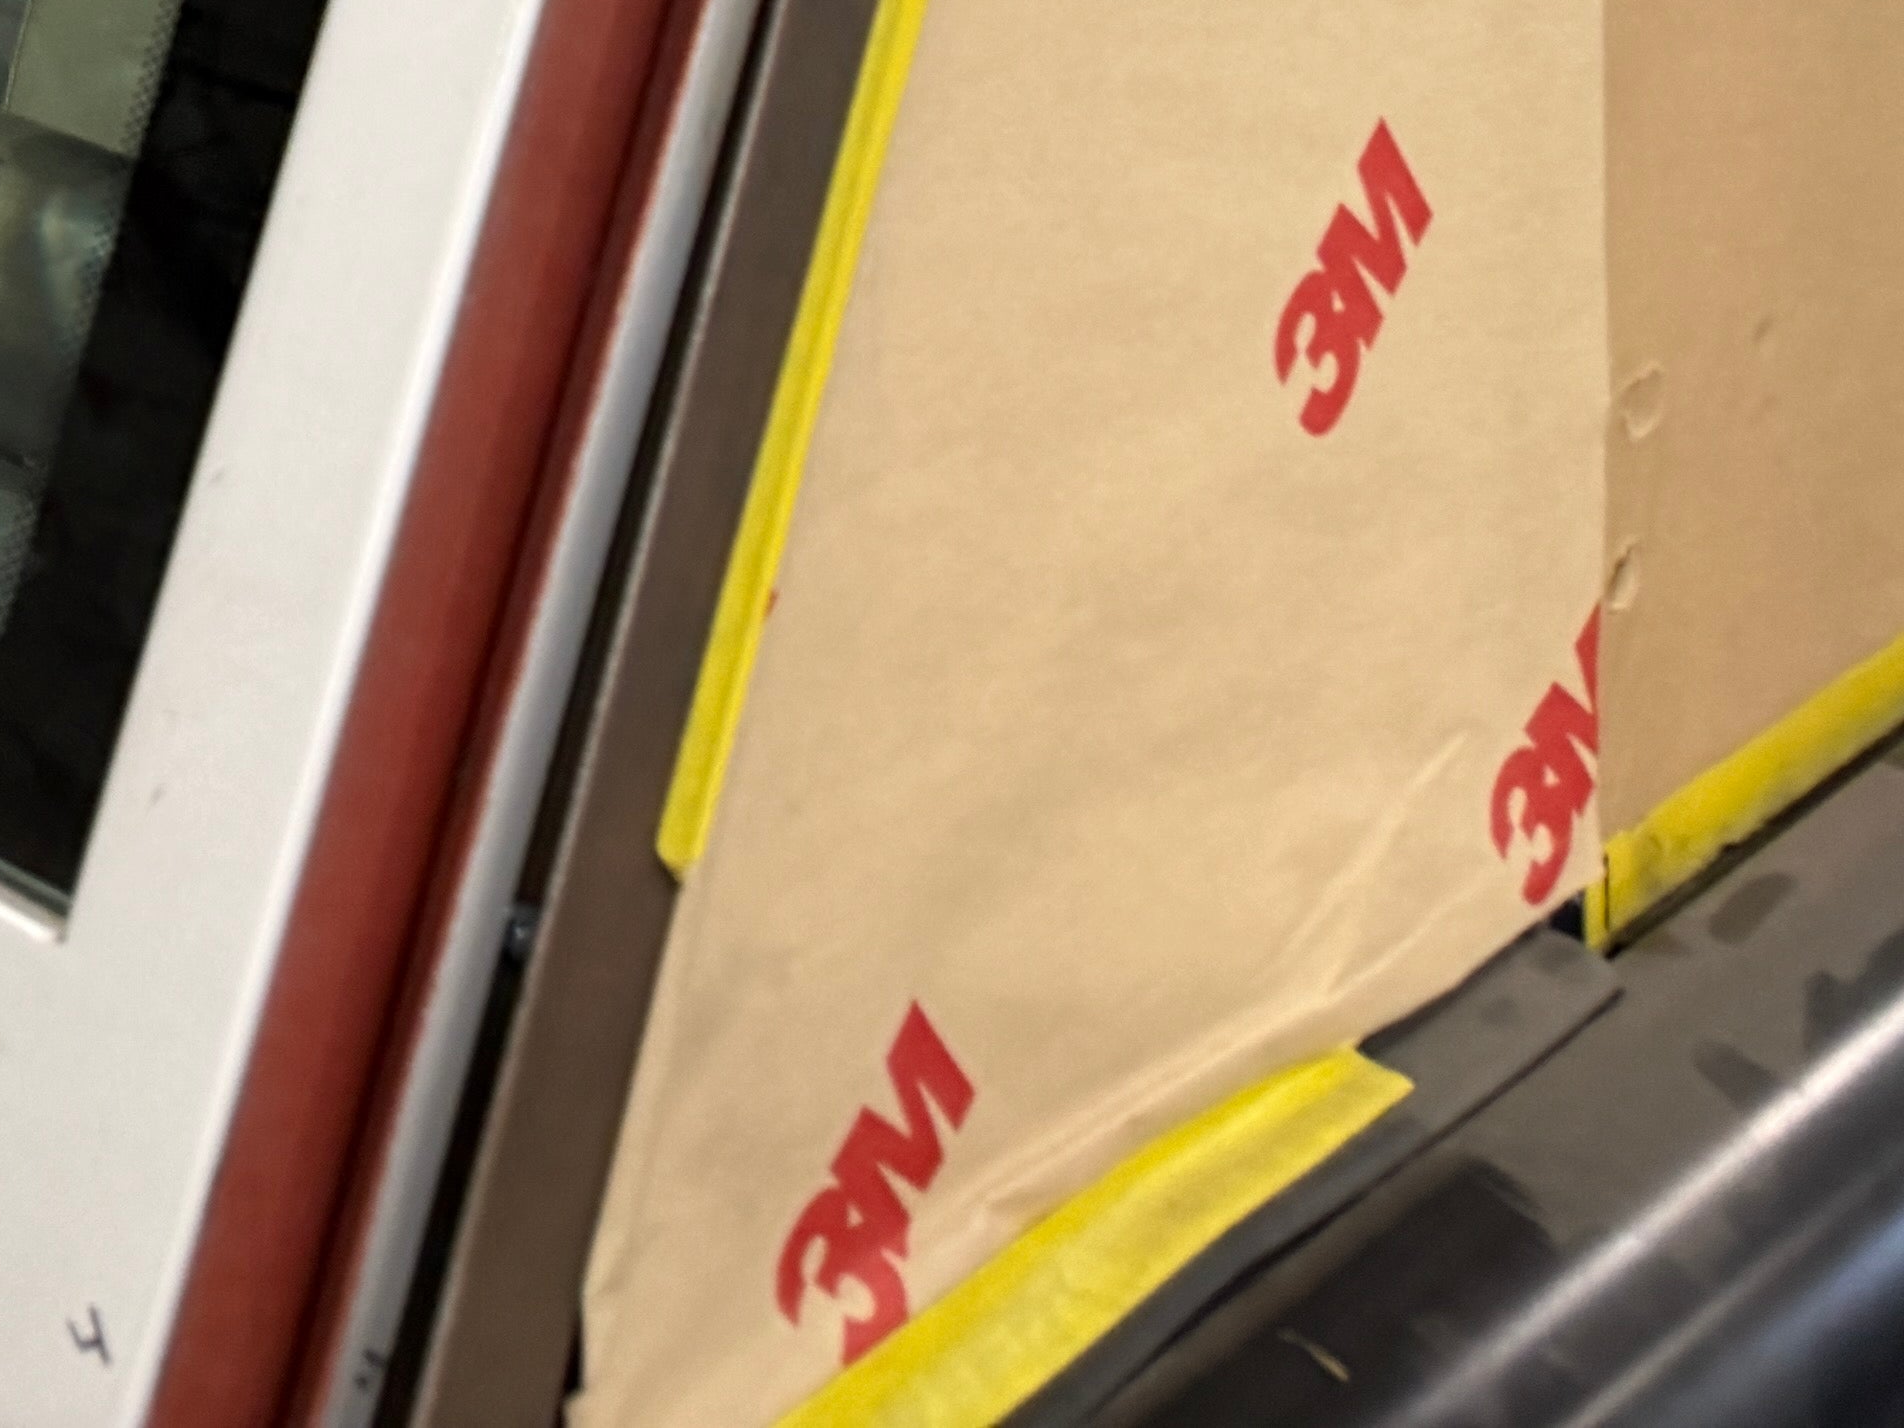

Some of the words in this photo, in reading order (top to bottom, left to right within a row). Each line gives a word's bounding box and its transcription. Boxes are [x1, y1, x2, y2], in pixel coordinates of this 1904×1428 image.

[1274, 117, 1433, 437] 3M
[64, 1304, 113, 1367] 4
[776, 999, 975, 1368] 3M
